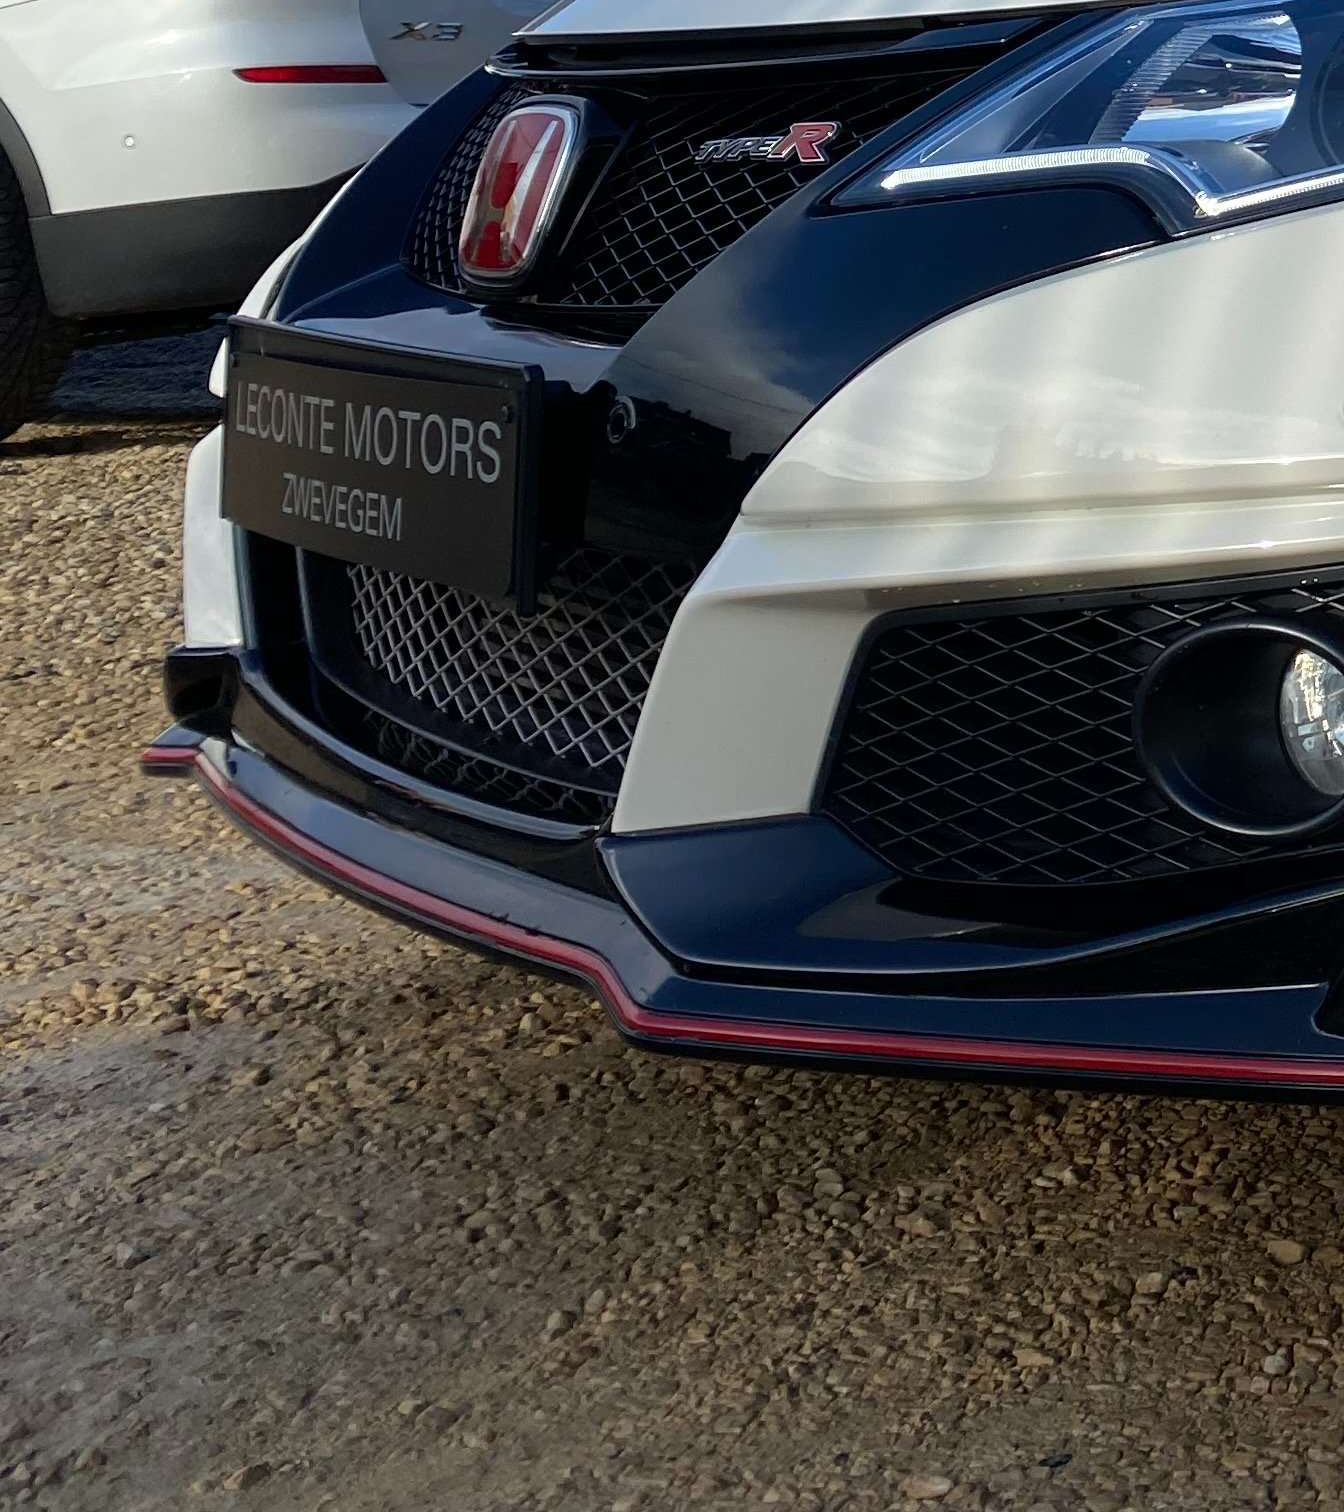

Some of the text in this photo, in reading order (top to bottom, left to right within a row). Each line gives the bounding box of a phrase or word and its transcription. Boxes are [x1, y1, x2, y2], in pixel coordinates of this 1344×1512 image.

[389, 20, 463, 41] X3
[694, 121, 841, 165] TYPE R
[235, 382, 500, 484] LECONTE MOTORS
[282, 472, 401, 541] ZWEVEGEM
